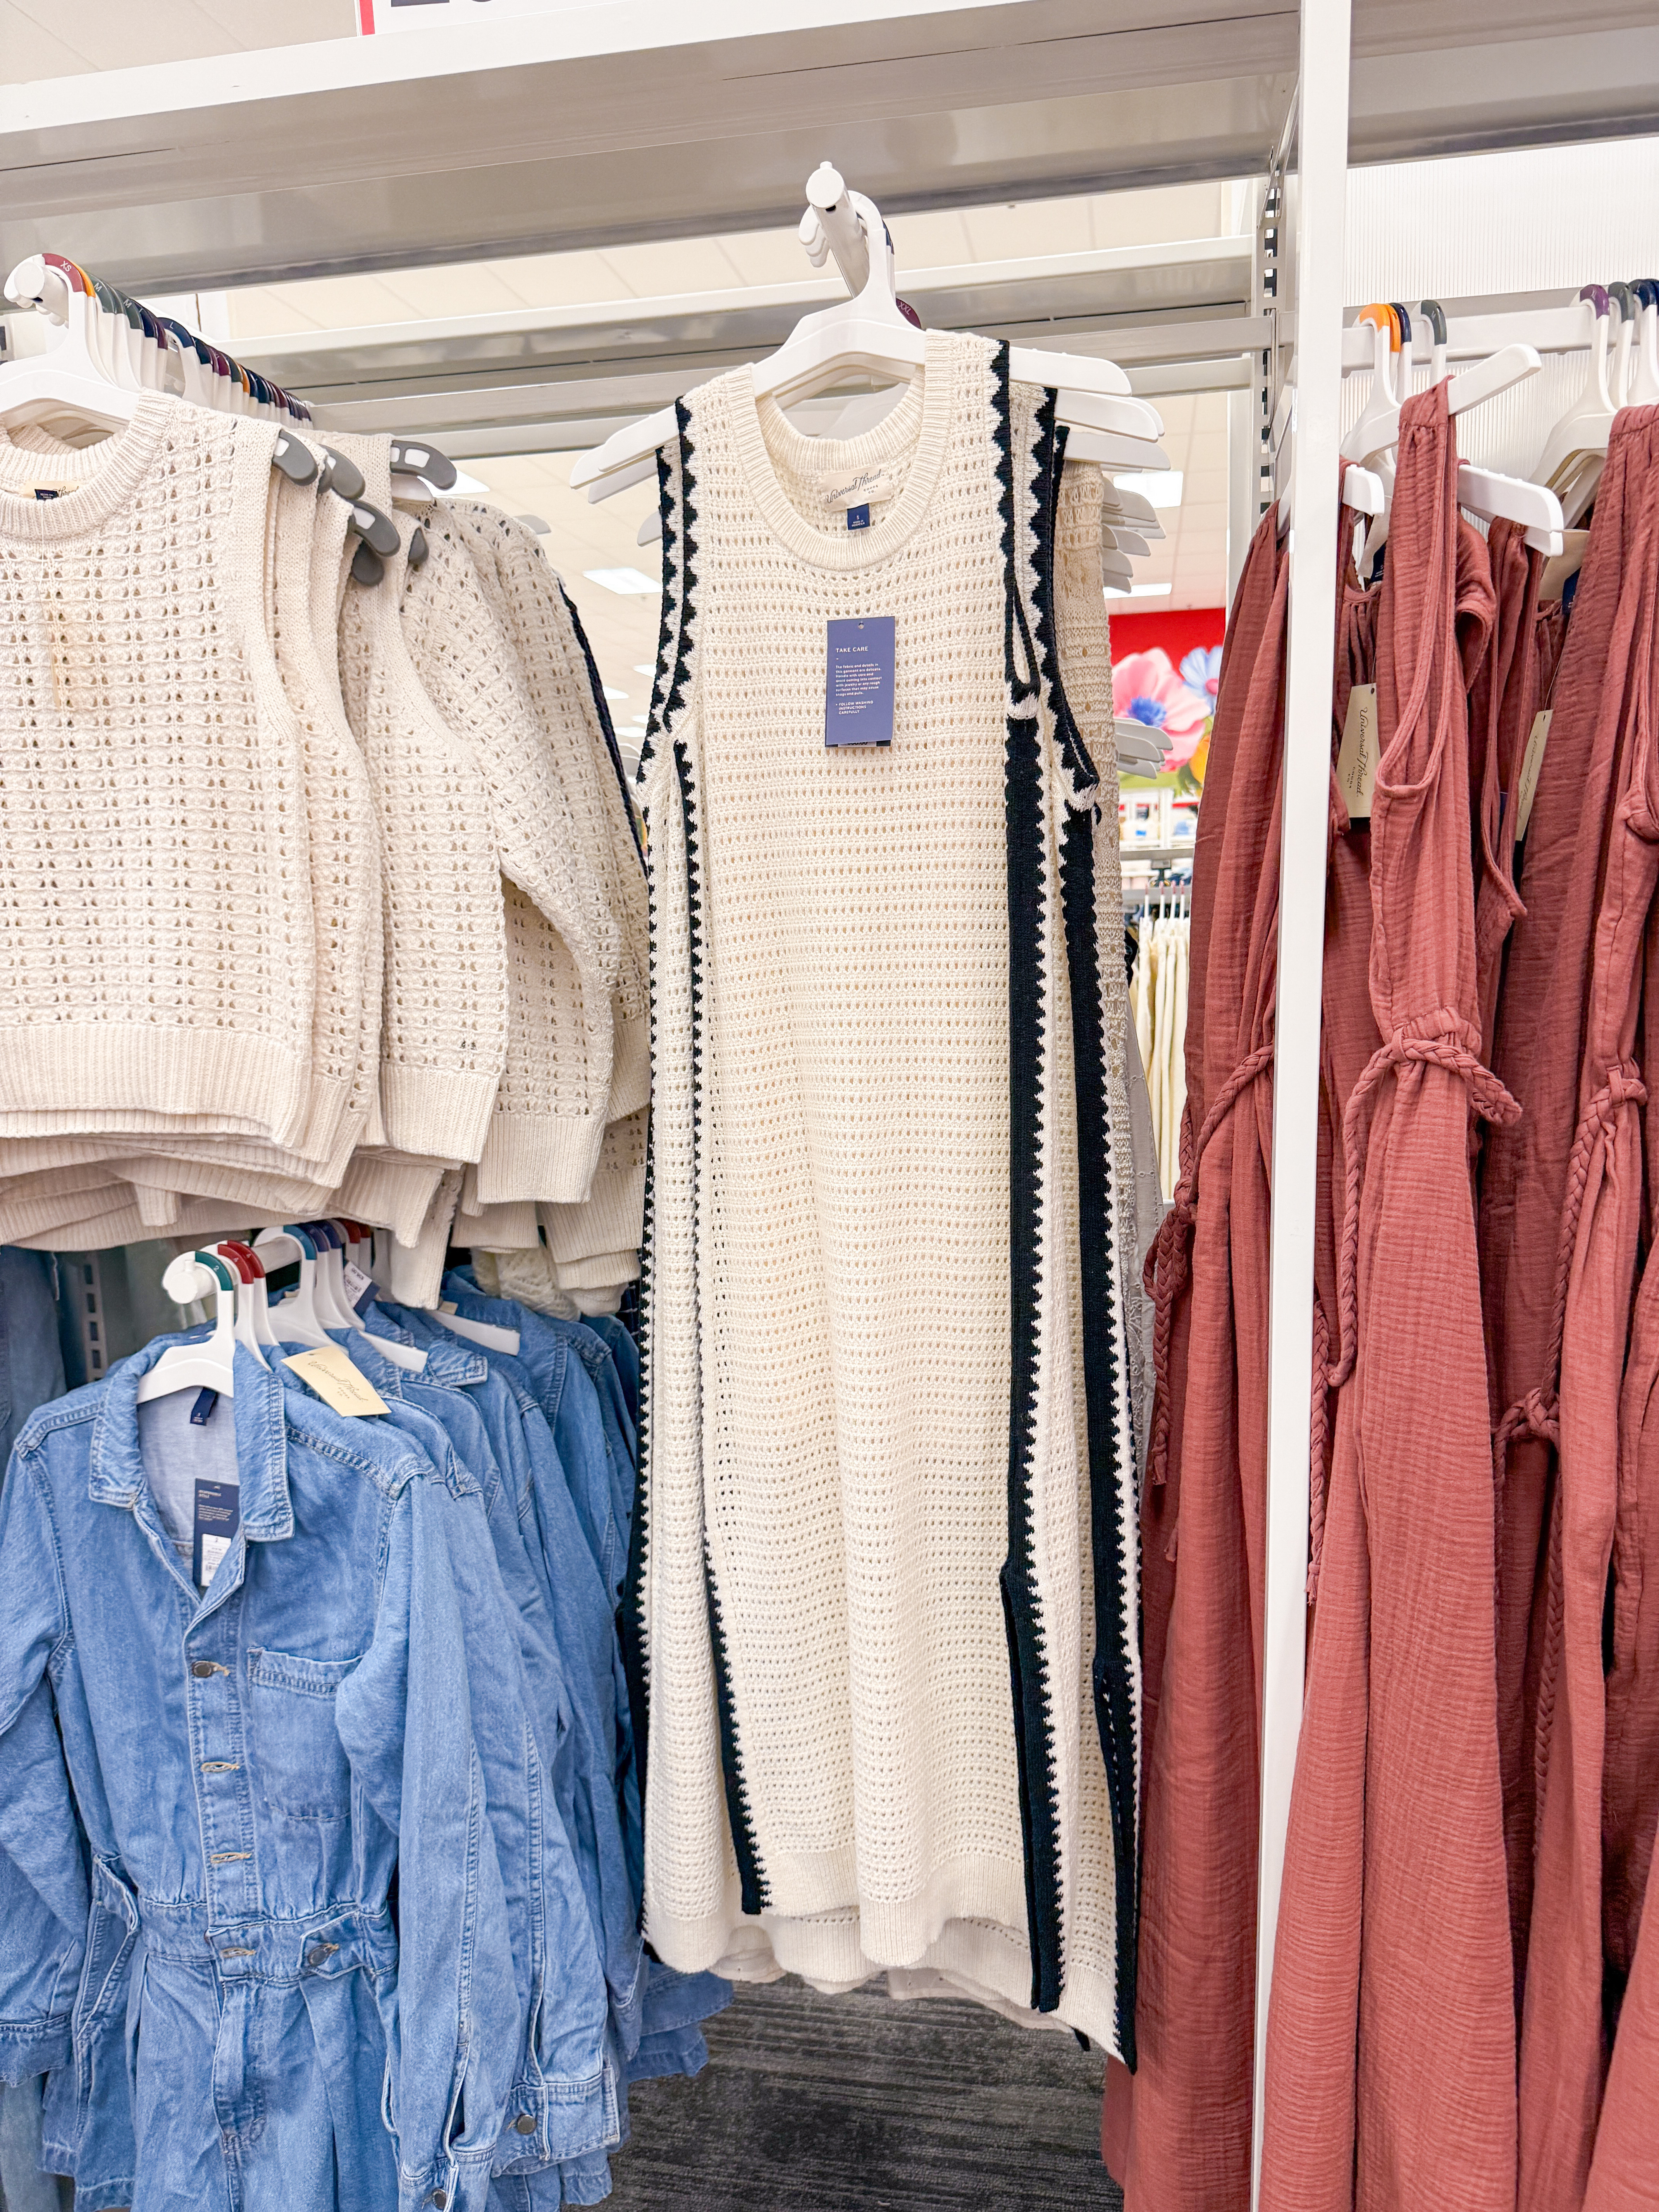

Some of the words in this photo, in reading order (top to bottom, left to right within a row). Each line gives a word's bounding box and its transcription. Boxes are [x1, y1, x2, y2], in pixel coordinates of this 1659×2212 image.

[60, 260, 72, 272] XS
[94, 282, 102, 292] M
[123, 298, 132, 308] M
[898, 302, 911, 315] XXL
[825, 479, 857, 503] Universal
[853, 469, 881, 491] Thread
[1359, 707, 1368, 759] Universal
[1356, 752, 1368, 796] Thread
[308, 1360, 348, 1382] Universal
[337, 1379, 368, 1401] Thread
